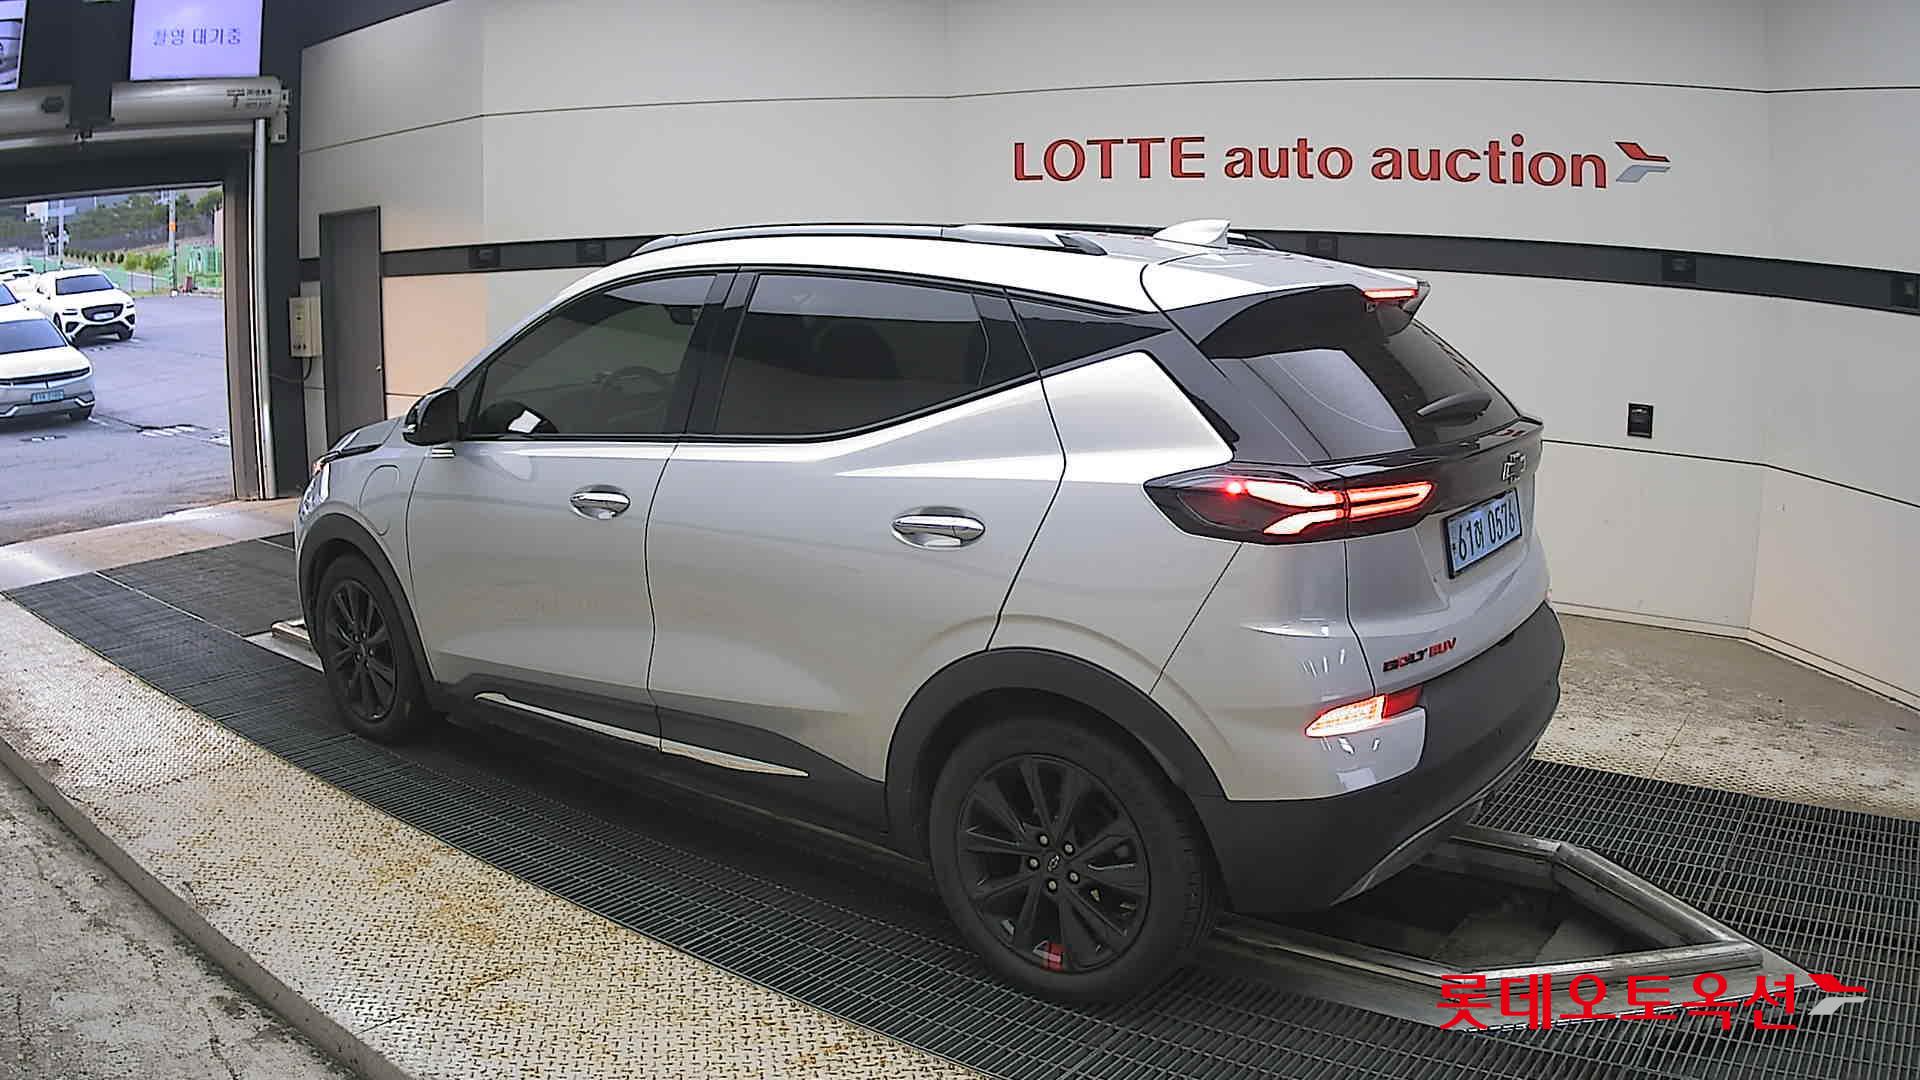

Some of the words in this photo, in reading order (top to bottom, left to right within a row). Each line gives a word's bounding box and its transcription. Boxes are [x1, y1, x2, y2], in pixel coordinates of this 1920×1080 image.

[192, 28, 240, 45] 대기중
[1013, 136, 1206, 181] LOTTE
[1223, 138, 1353, 180] auto
[1371, 133, 1607, 189] auction
[1487, 498, 1516, 544] 0576
[1382, 647, 1428, 673] BOLT
[1429, 636, 1457, 658] EUV
